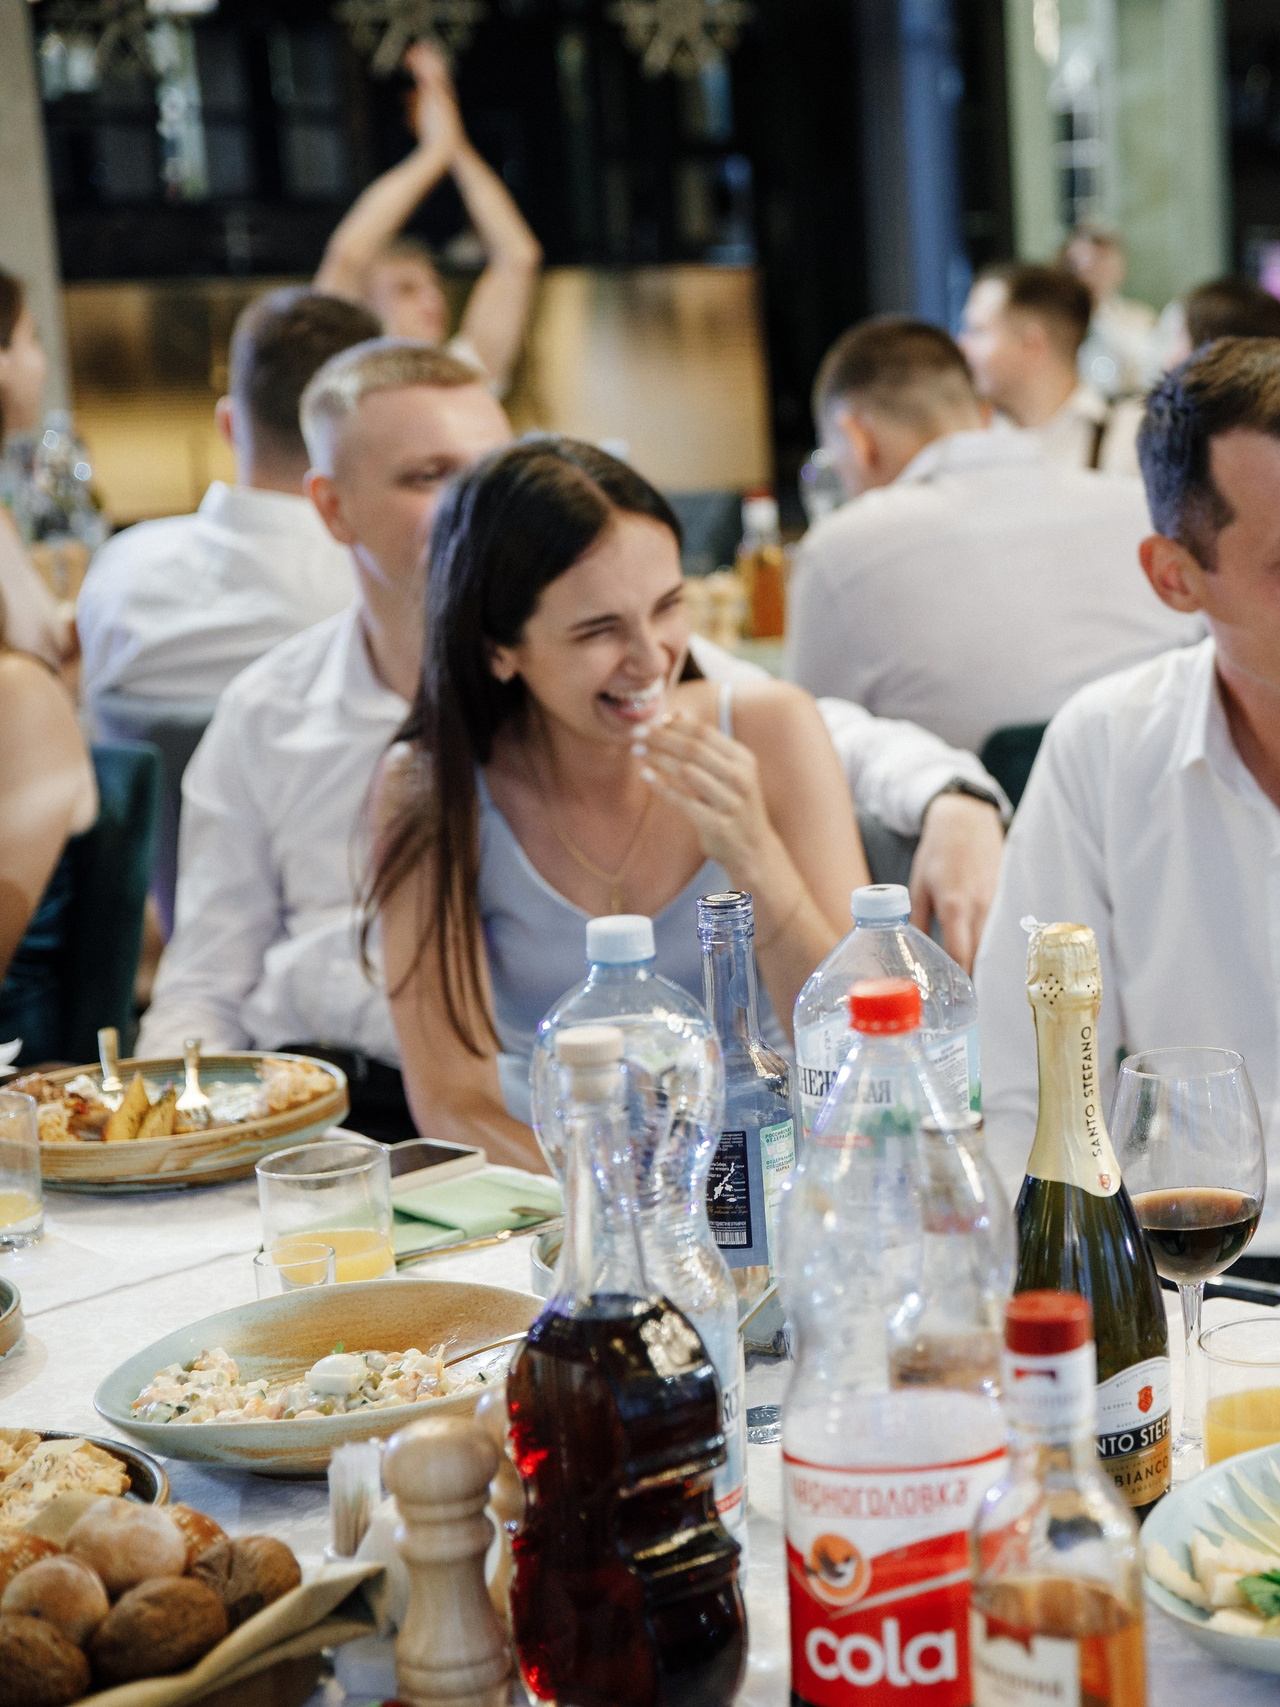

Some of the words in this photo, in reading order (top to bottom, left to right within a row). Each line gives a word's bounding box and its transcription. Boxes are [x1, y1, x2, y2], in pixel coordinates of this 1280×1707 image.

[1081, 1026, 1094, 1098] STEFANO
[1085, 1104, 1102, 1157] SANTO
[1096, 1434, 1134, 1456] NTO
[1114, 1456, 1169, 1488] BIANCO
[805, 1617, 958, 1687] cola
